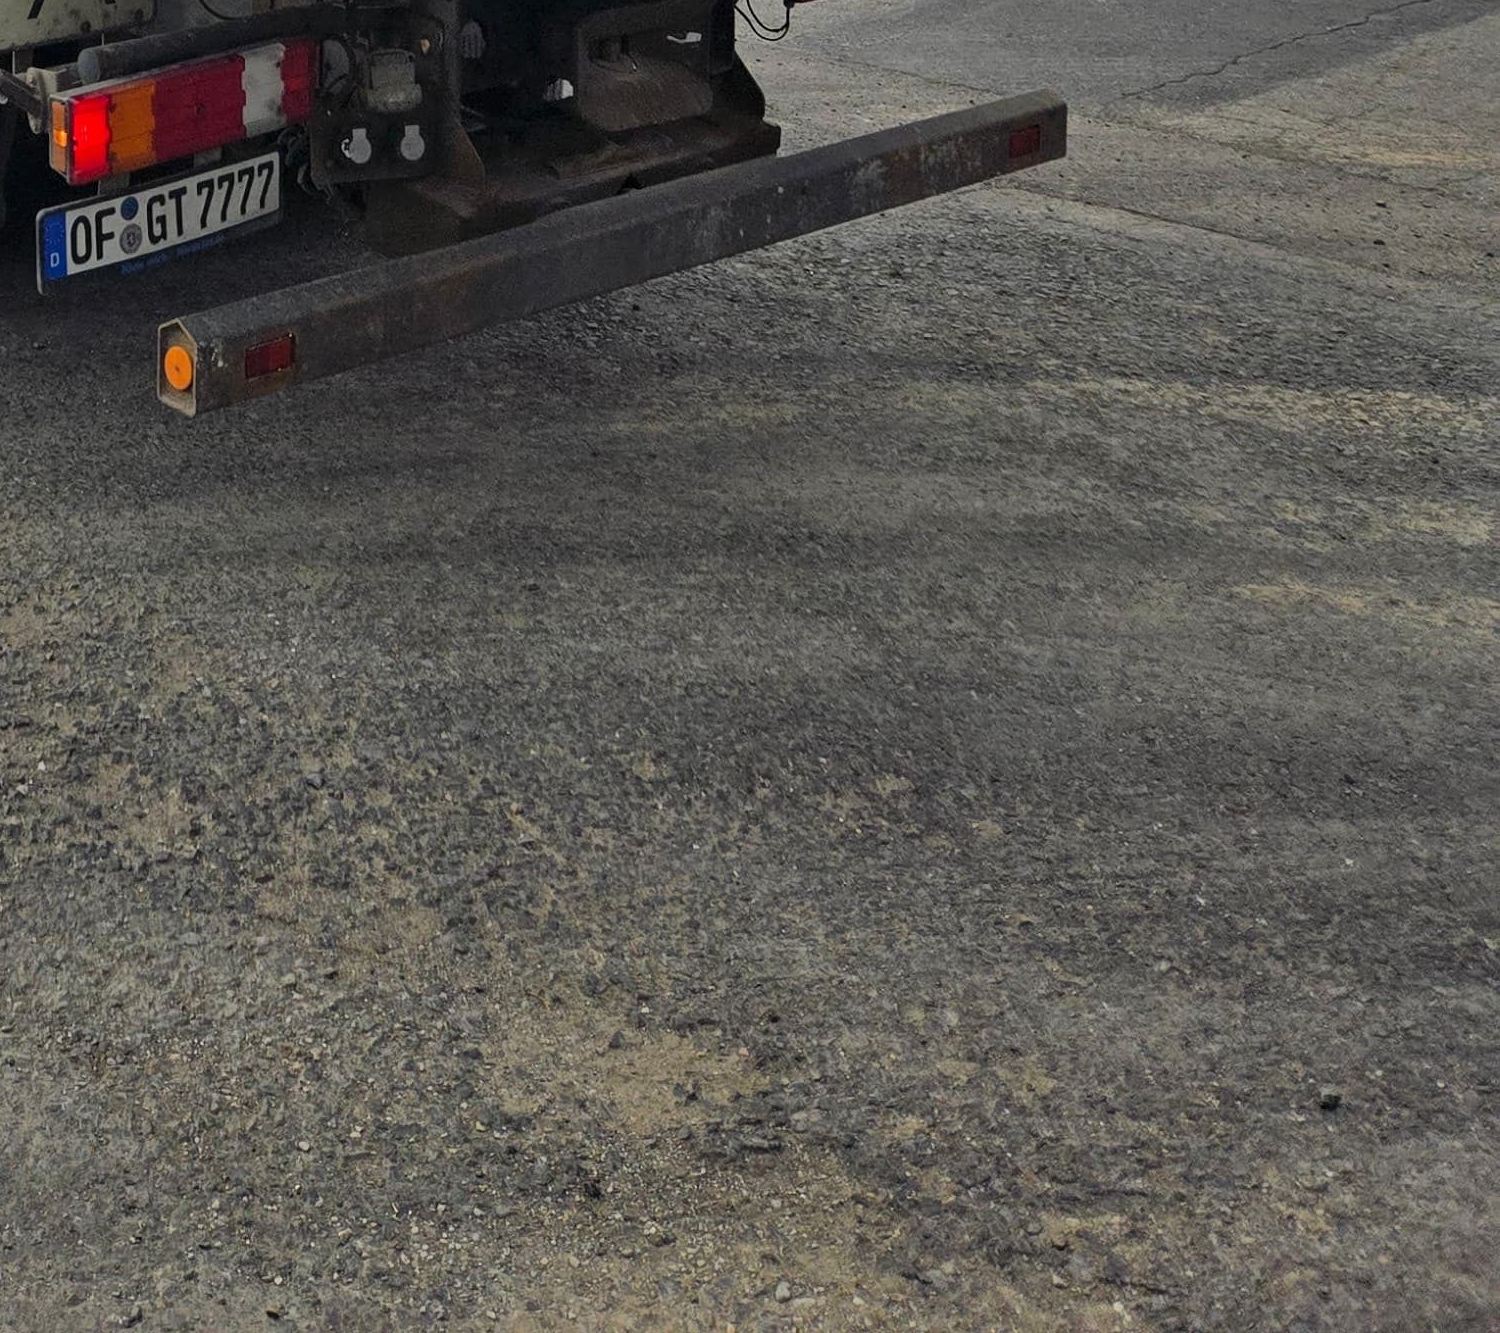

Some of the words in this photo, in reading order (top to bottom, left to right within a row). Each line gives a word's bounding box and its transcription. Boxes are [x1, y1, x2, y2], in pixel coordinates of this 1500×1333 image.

[50, 252, 60, 268] D
[70, 206, 117, 265] OF
[147, 185, 188, 245] GT
[197, 160, 275, 229] 7777
